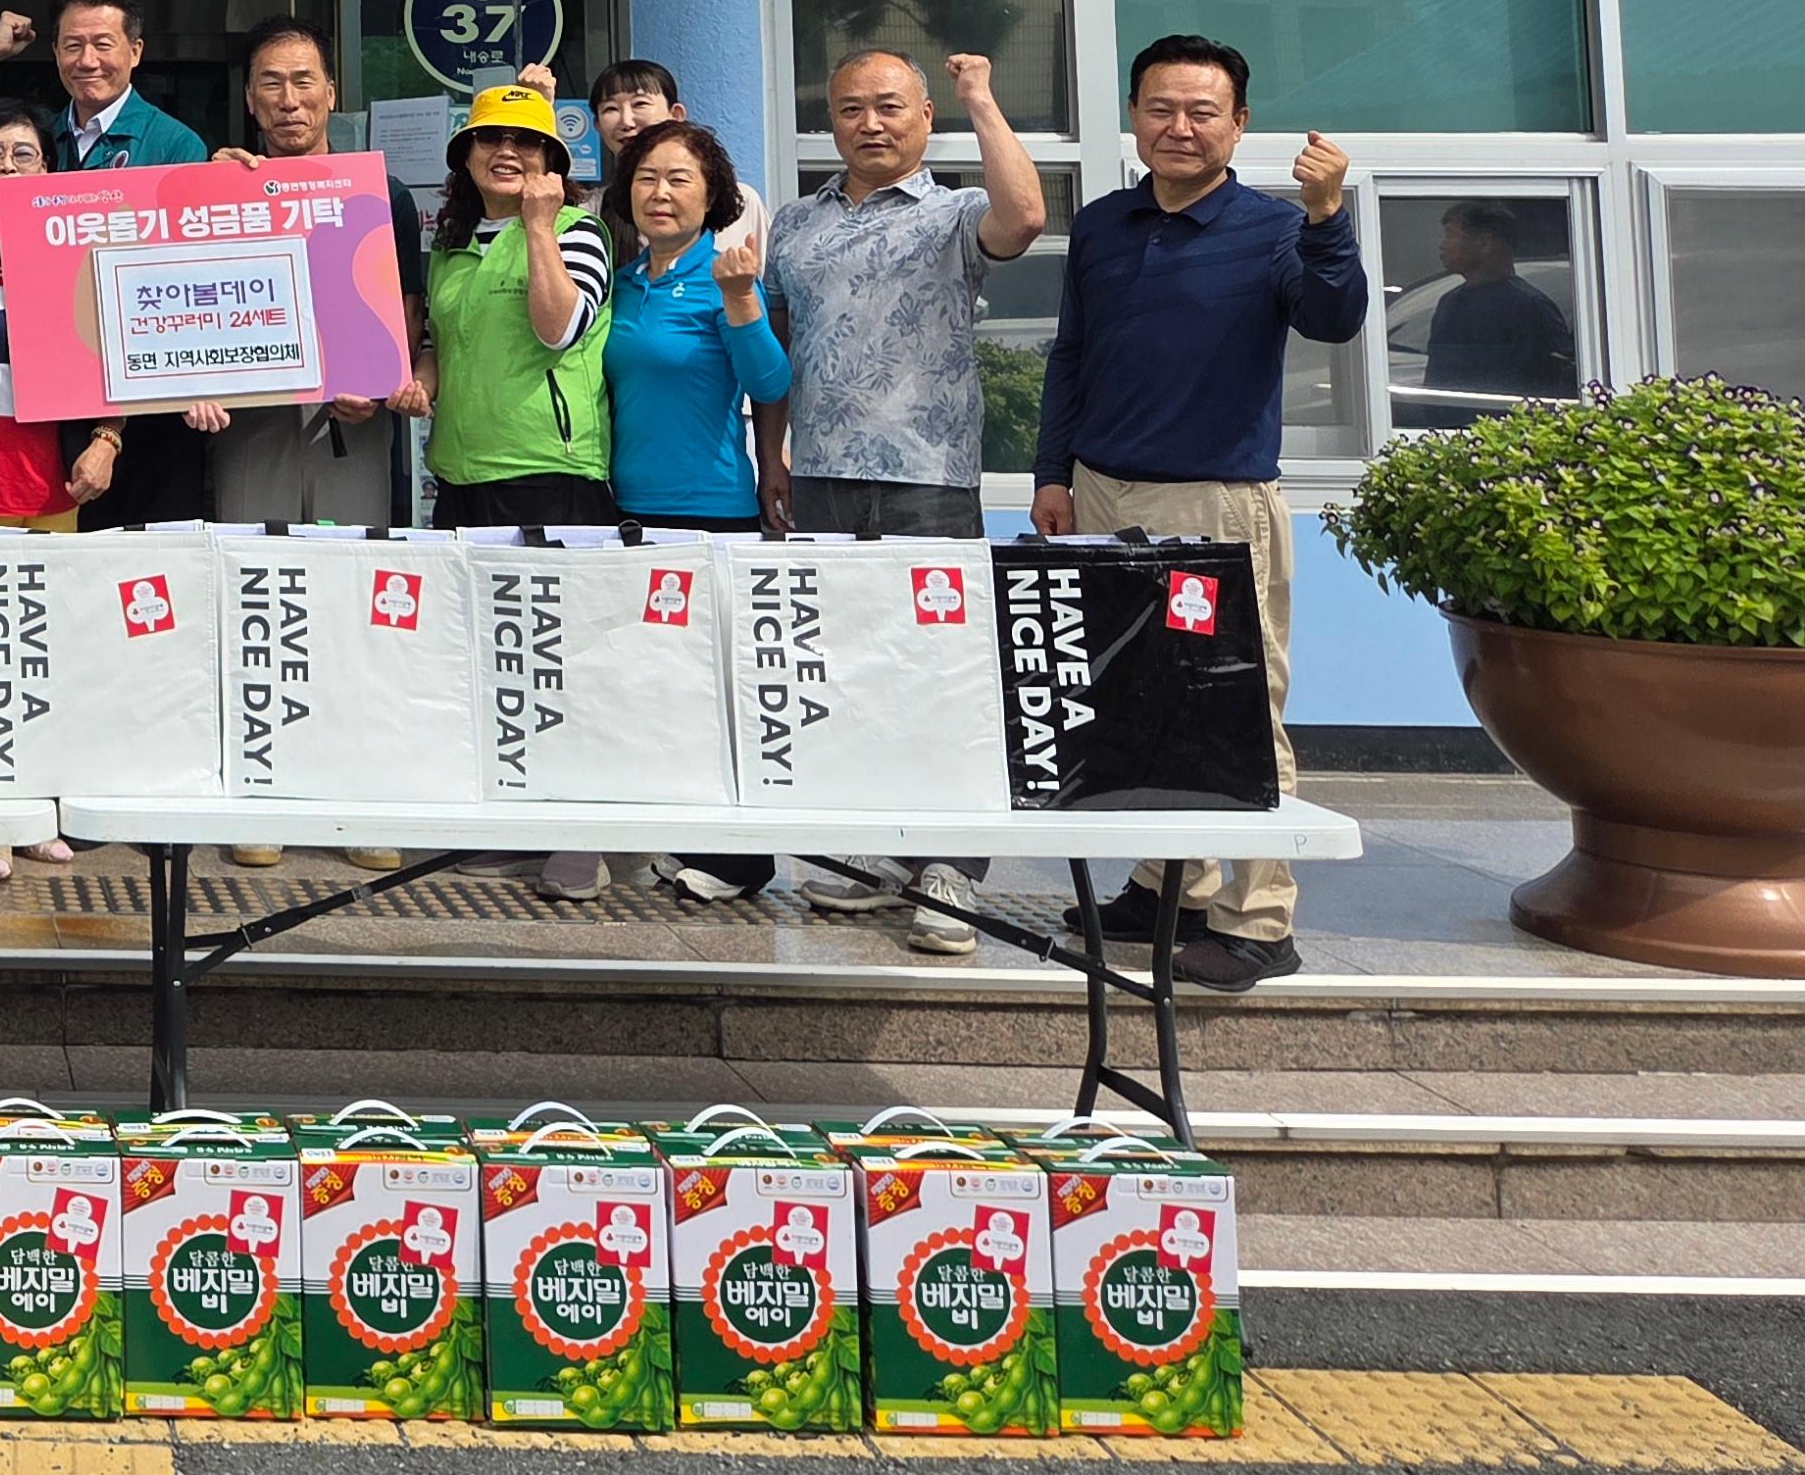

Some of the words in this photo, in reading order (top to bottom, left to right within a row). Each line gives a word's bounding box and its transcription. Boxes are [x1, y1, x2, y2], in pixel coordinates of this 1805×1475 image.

[440, 4, 526, 43] 37
[46, 208, 169, 245] 이웃돕기
[179, 202, 272, 237] 성금품
[282, 197, 344, 231] 기탁
[137, 279, 275, 310] 찾아봄데이
[130, 312, 222, 334] 건강꾸러미
[230, 308, 287, 329] 24세트
[127, 354, 157, 372] 동면
[165, 344, 300, 369] 지역사회보장협의체
[17, 564, 49, 679] HAVE
[241, 567, 271, 668] NICE
[279, 568, 309, 683] HAVE
[492, 574, 524, 675] NICE
[530, 576, 564, 691] HAVE
[751, 568, 787, 669] NICE
[789, 568, 827, 683] HAVE
[1007, 570, 1048, 673] NICE
[1048, 568, 1092, 687] HAVE
[21, 691, 50, 723] A
[281, 695, 310, 726] A
[534, 702, 564, 734] A
[798, 695, 830, 728] A
[1060, 698, 1096, 731] A
[243, 684, 273, 785] DAY!
[496, 688, 526, 789] DAY!
[758, 685, 793, 787] DAY!
[1019, 687, 1060, 791] DAY!
[131, 1164, 165, 1199] 증정
[310, 1170, 344, 1204] 증정
[494, 1171, 527, 1206] 증정
[682, 1175, 716, 1209] 증정
[876, 1177, 909, 1212] 증정
[1062, 1180, 1096, 1214] 증정
[11, 1250, 57, 1265] 담백한
[189, 1251, 235, 1266] 달콤한
[554, 1259, 601, 1276] 담백한
[743, 1262, 790, 1280] 담백한
[938, 1264, 985, 1282] 달콤한
[172, 1268, 253, 1294] 베지밀
[352, 1272, 433, 1298] 베지밀
[537, 1277, 620, 1303] 베지밀
[1123, 1266, 1171, 1284] 달콤한
[12, 1293, 55, 1313] 에이
[202, 1294, 227, 1314] 비
[382, 1298, 407, 1318] 비
[726, 1281, 809, 1307] 베지밀
[921, 1283, 1004, 1309] 베지밀
[1106, 1285, 1190, 1310] 베지밀
[557, 1303, 601, 1324] 에이
[746, 1307, 790, 1327] 에이
[952, 1309, 978, 1329] 비
[1137, 1310, 1163, 1331] 비
